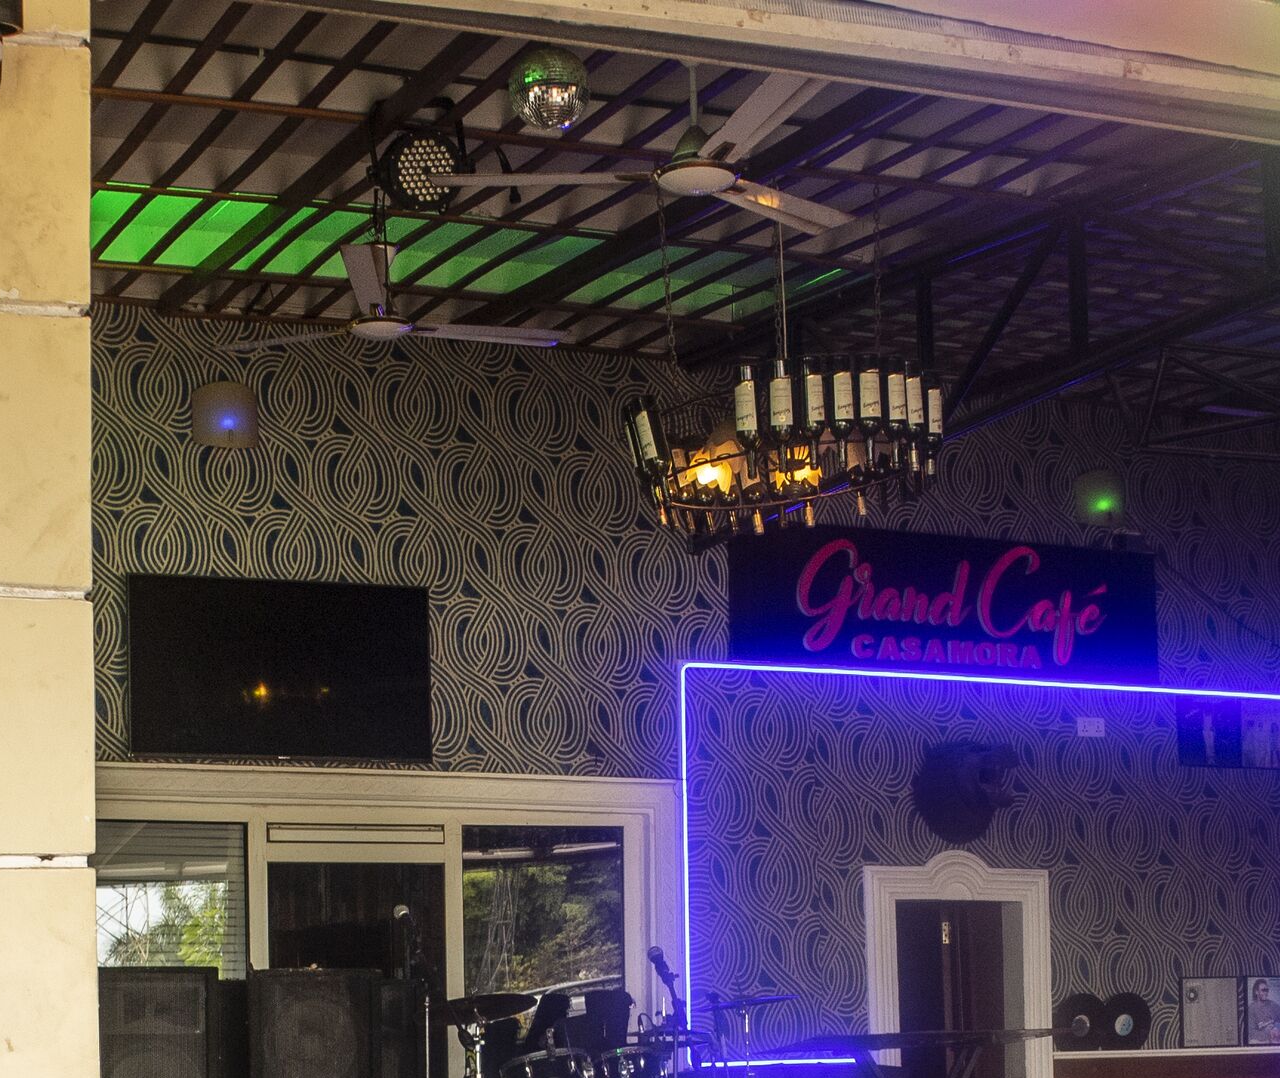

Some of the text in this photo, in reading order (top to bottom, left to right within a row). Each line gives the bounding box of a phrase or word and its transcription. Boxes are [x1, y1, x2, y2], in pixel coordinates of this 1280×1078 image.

[796, 538, 1108, 667] Grand Café
[850, 634, 1043, 670] CASAMORA
